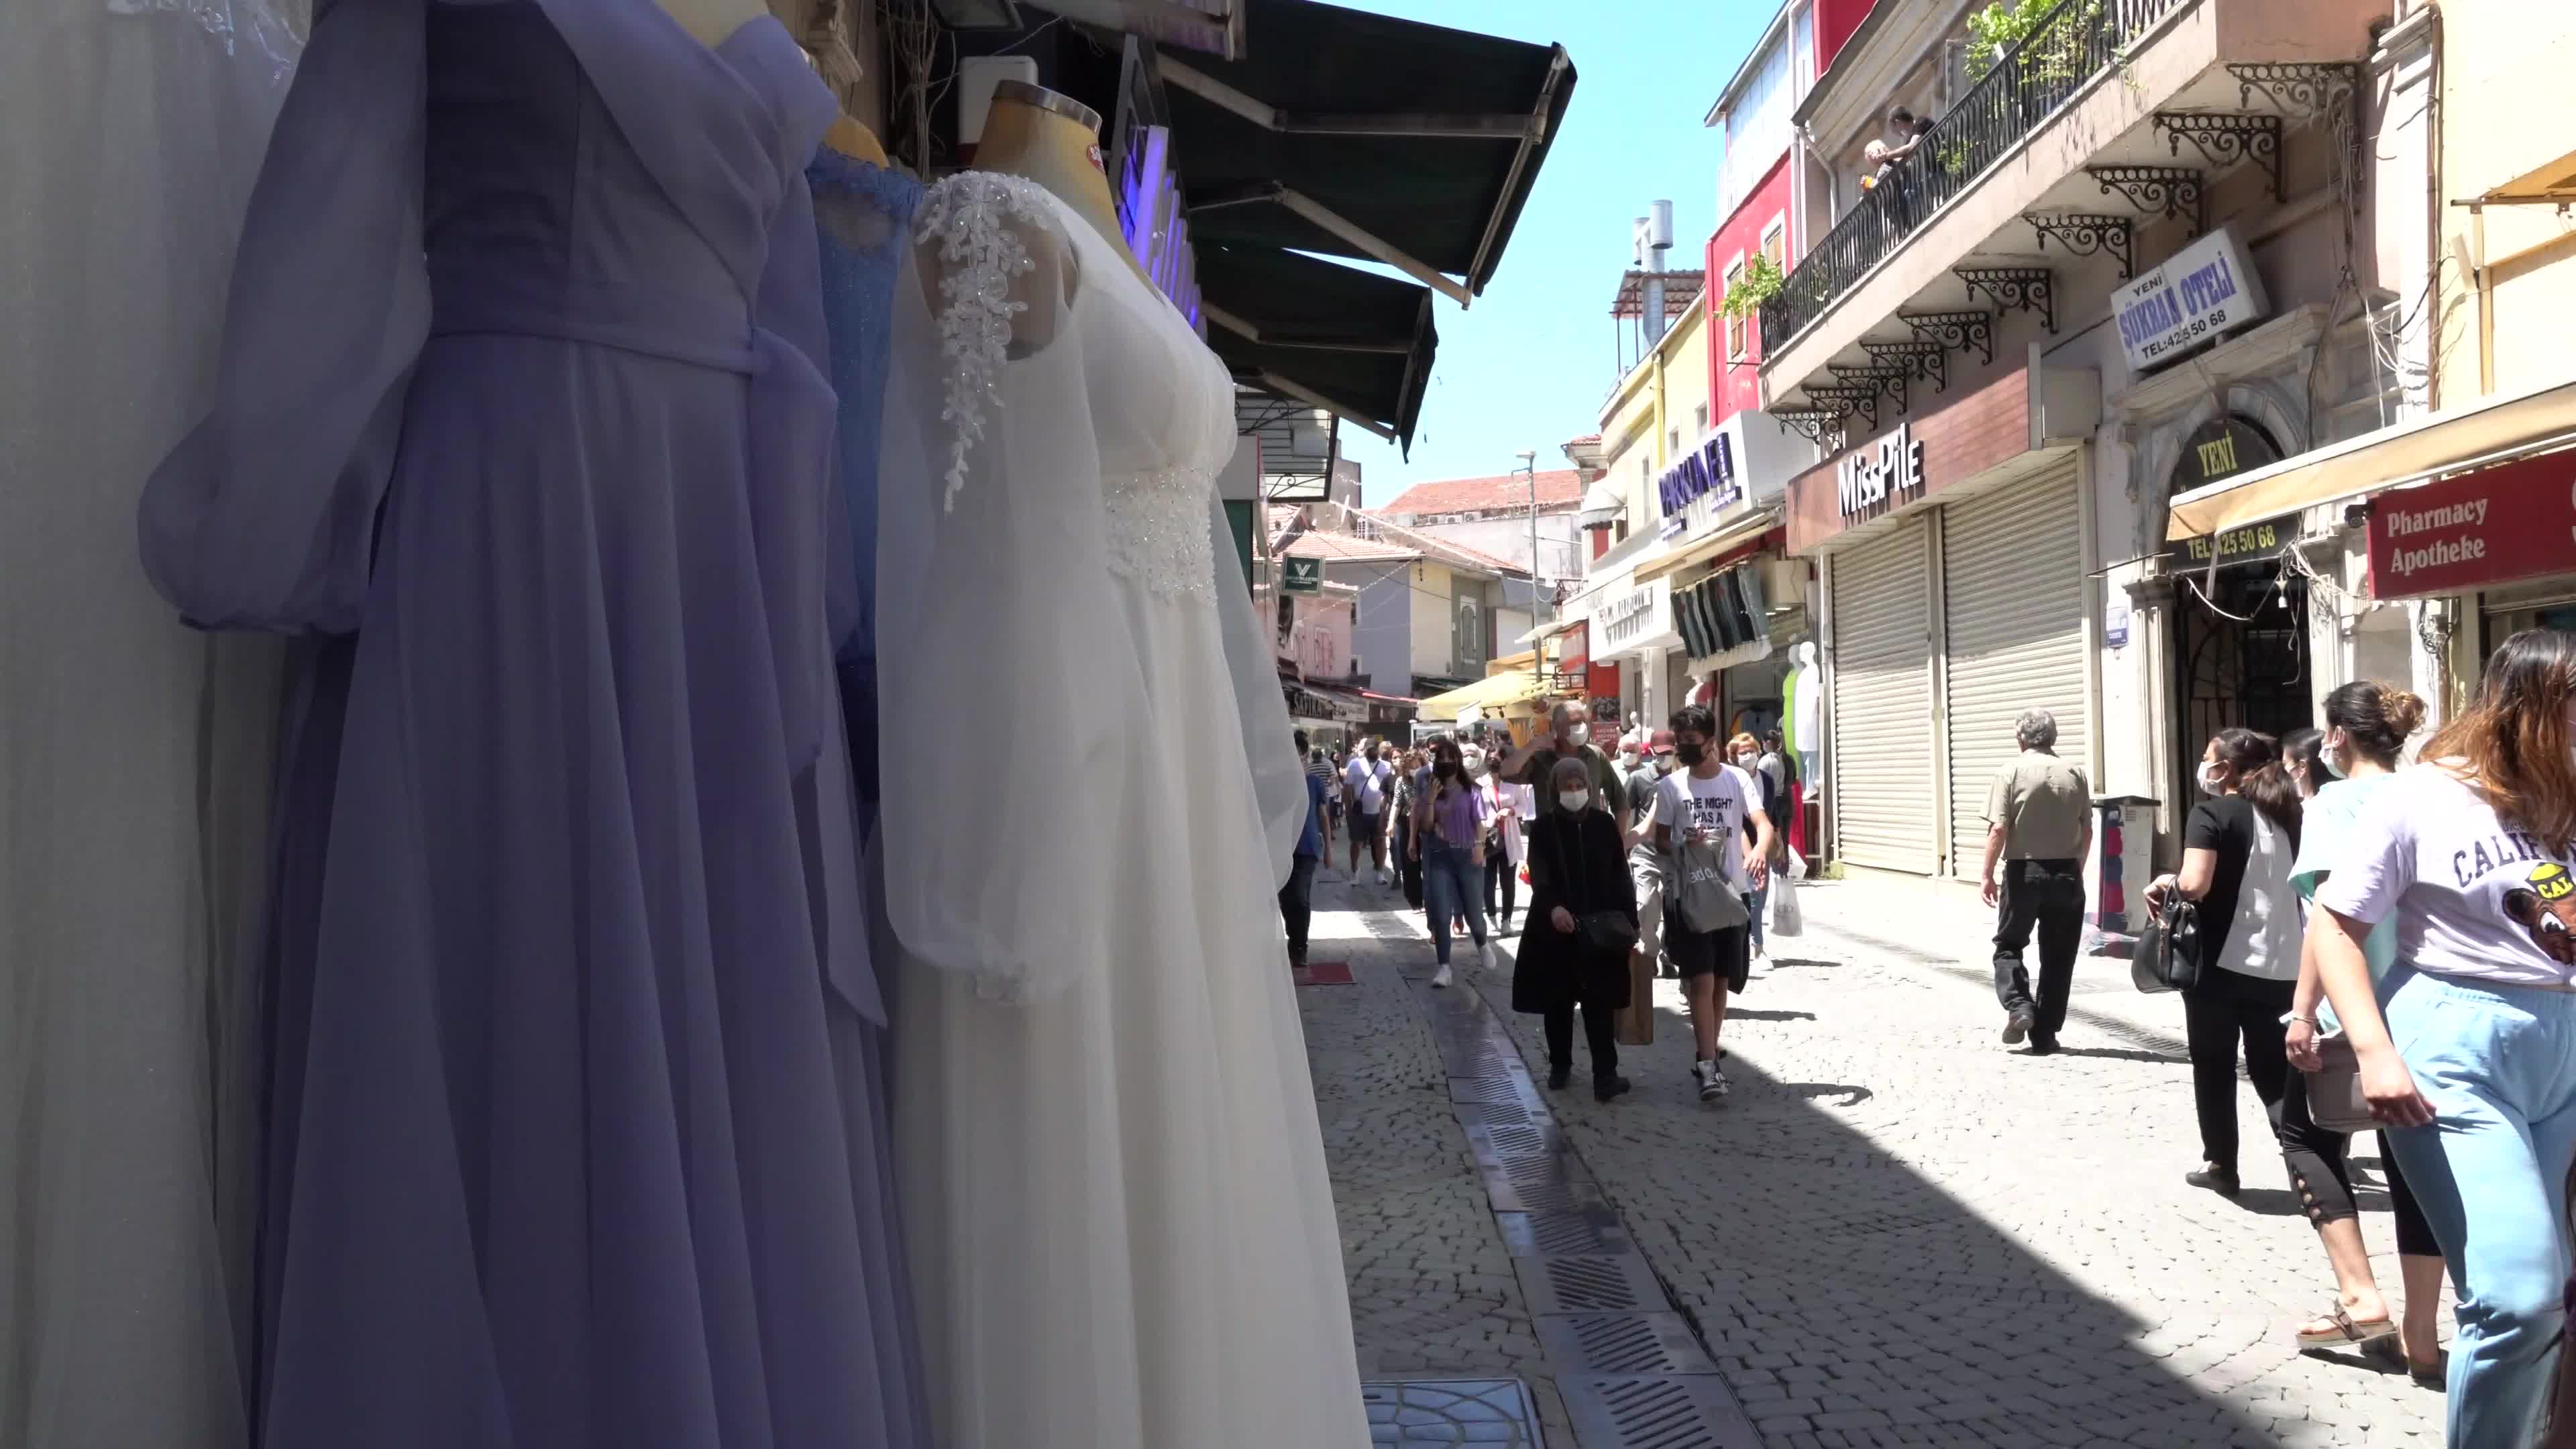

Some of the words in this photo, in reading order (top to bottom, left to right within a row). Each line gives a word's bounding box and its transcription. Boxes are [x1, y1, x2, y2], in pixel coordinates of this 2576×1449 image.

[2180, 250, 2237, 316] OTELİ
[2190, 320, 2206, 335] 50
[2210, 309, 2226, 326] 68
[2197, 429, 2238, 477] YENİ
[2387, 498, 2488, 537] Pharmacy
[2239, 529, 2255, 551] 50
[2257, 525, 2275, 548] 68
[2390, 535, 2485, 576] Apotheke
[1682, 797, 1702, 810] THE
[1705, 796, 1733, 810] NIGHT
[1694, 811, 1713, 824] HAS
[1717, 812, 1723, 824] A
[2538, 876, 2574, 899] CAL
